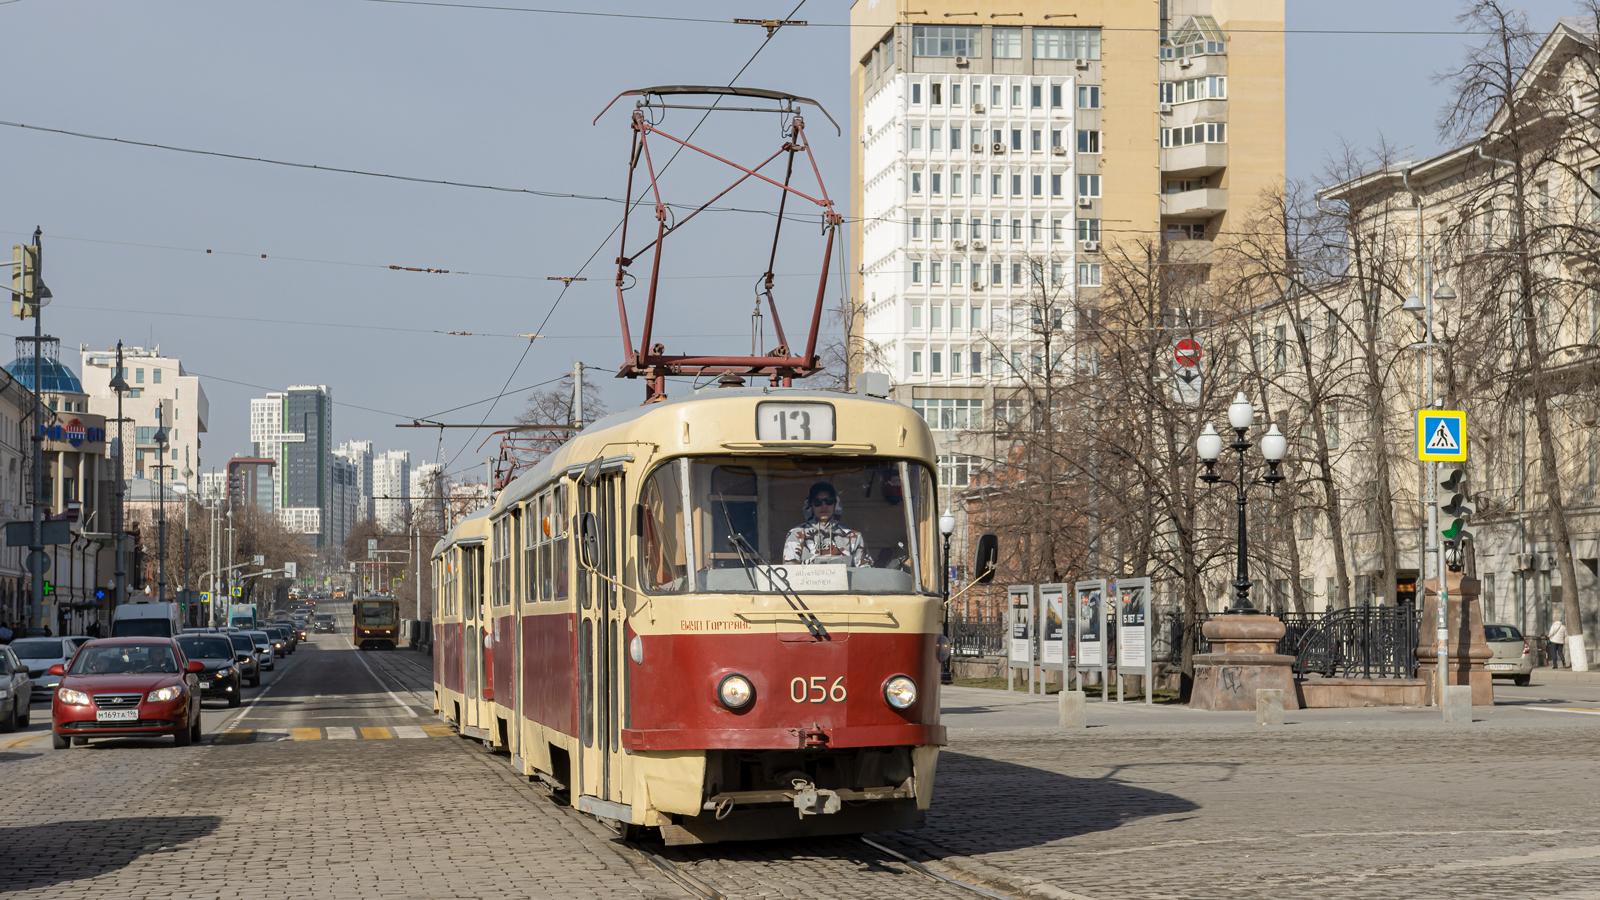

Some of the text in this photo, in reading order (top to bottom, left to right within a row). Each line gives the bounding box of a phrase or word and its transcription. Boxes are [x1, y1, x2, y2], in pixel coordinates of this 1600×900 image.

[773, 411, 811, 440] 13
[766, 567, 790, 591] 13
[790, 676, 847, 704] 056
[98, 711, 126, 720] М169ТА
